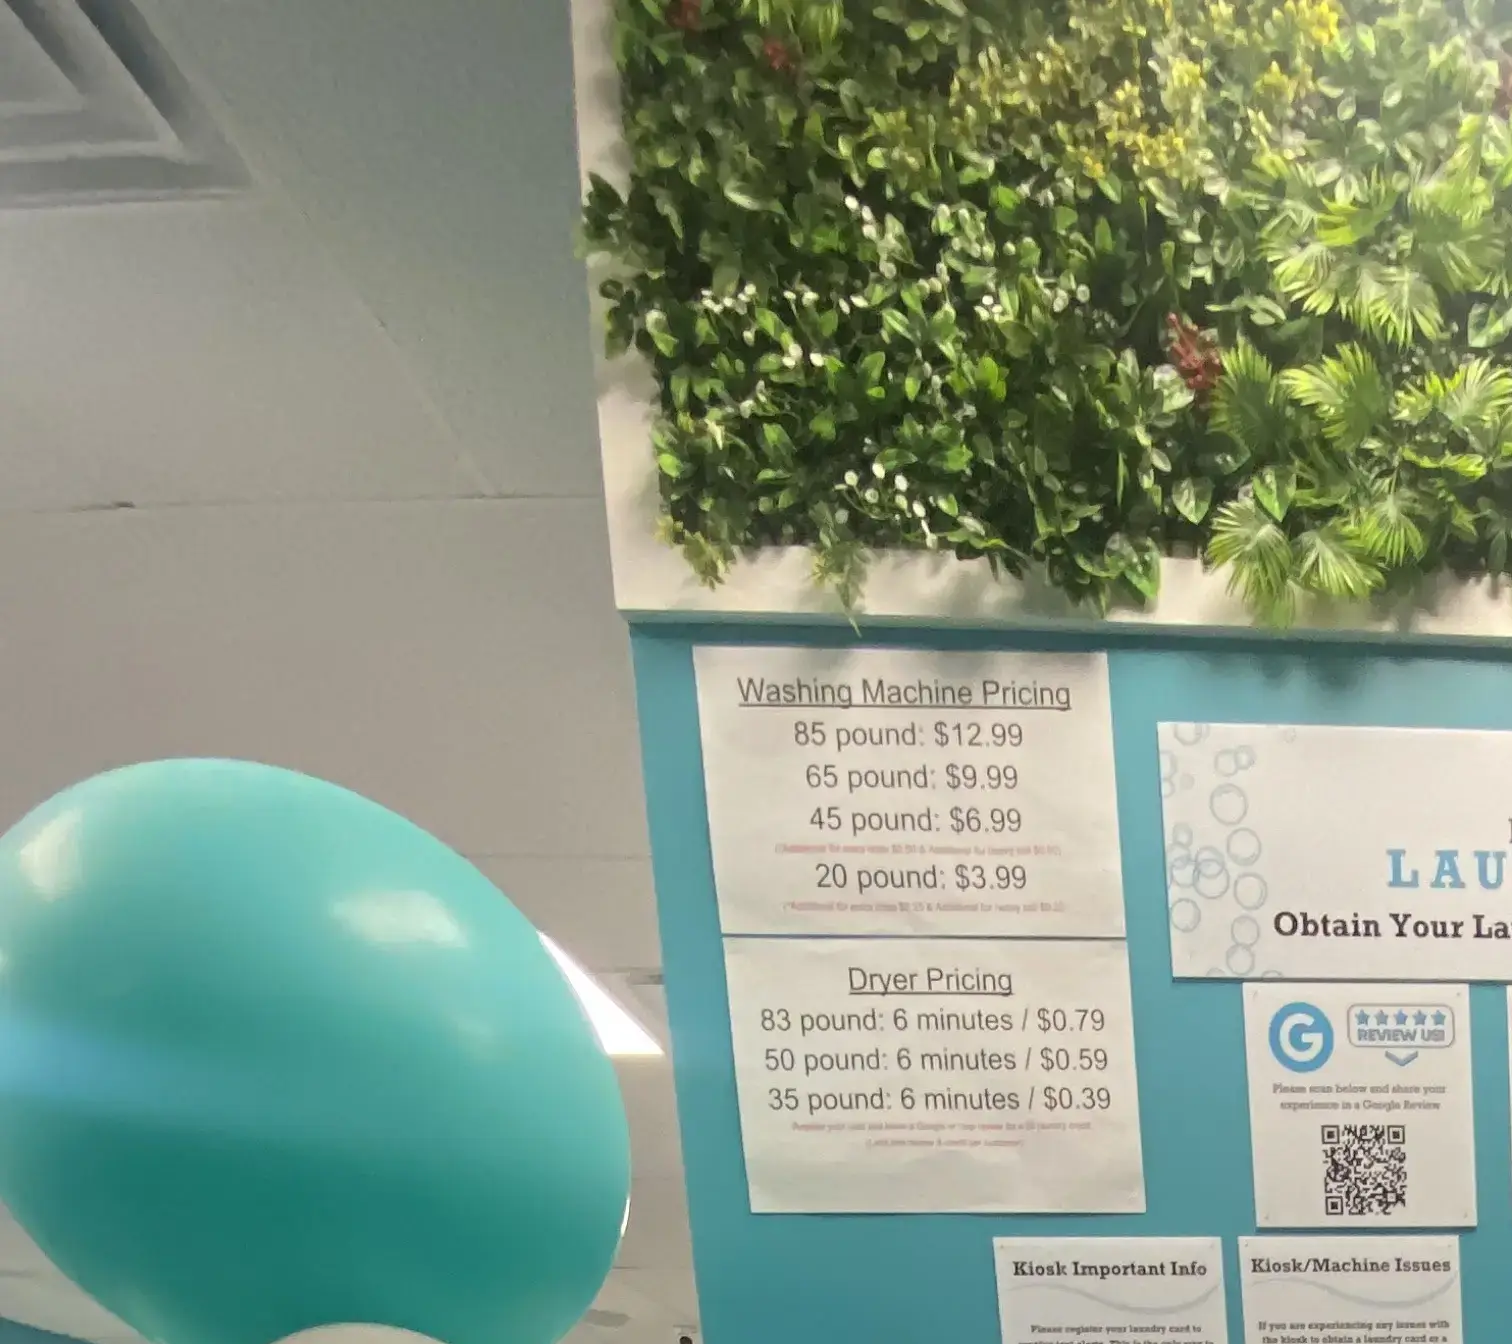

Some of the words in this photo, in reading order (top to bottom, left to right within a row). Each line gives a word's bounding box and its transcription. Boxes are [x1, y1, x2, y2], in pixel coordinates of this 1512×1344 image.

[737, 677, 852, 708] Washing
[862, 679, 972, 705] Machine
[983, 680, 1070, 711] Pricing
[794, 721, 826, 746] 85
[836, 722, 924, 751] pound:
[935, 722, 1023, 747] $12.99
[806, 765, 837, 787] 65
[848, 765, 936, 793] pound:
[946, 763, 1018, 789] $9.99
[810, 807, 841, 830] 45
[852, 808, 940, 835] pound:
[950, 807, 1022, 833] $6.99
[816, 864, 847, 888] 20
[857, 865, 945, 893] pound:
[956, 864, 1026, 891] $3.99
[1274, 912, 1381, 937] Obtain
[1389, 913, 1463, 938] Your
[849, 968, 917, 996] Dryer
[927, 968, 1012, 996] Pricing
[761, 1009, 790, 1031] 83
[802, 1009, 883, 1036] pound:
[893, 1009, 908, 1030] 6
[918, 1009, 1013, 1031] minutes
[1038, 1008, 1104, 1032] $0.79
[1358, 1029, 1416, 1041] REVIEW
[765, 1049, 794, 1070] 50
[805, 1048, 887, 1076] pound:
[897, 1048, 911, 1070] 6
[922, 1048, 1016, 1070] minutes
[1041, 1048, 1108, 1071] $0.59
[768, 1088, 798, 1110] 35
[809, 1088, 891, 1115] pound:
[901, 1088, 915, 1110] 6
[925, 1087, 1019, 1110] minutes
[1044, 1087, 1111, 1110] $0.39
[1273, 1083, 1306, 1094] Please
[1309, 1085, 1332, 1094] scan
[1336, 1084, 1367, 1094] below
[1370, 1085, 1389, 1094] and
[1392, 1084, 1420, 1094] share
[1424, 1086, 1445, 1096] your
[1280, 1101, 1339, 1112] experience
[1342, 1101, 1352, 1109] in
[1363, 1100, 1401, 1112] Google
[1404, 1100, 1440, 1110] Review
[1013, 1261, 1067, 1276] Kiosk
[1073, 1262, 1166, 1279] Important
[1170, 1261, 1207, 1276] Info
[1251, 1258, 1390, 1273] Kiosk/Machine
[1395, 1258, 1451, 1272] Issues
[1262, 1336, 1278, 1344] the
[1281, 1336, 1307, 1344] kiosk
[1310, 1336, 1319, 1344] to
[1322, 1335, 1353, 1344] obtain
[1364, 1335, 1401, 1344] laundry
[1405, 1335, 1426, 1343] card
